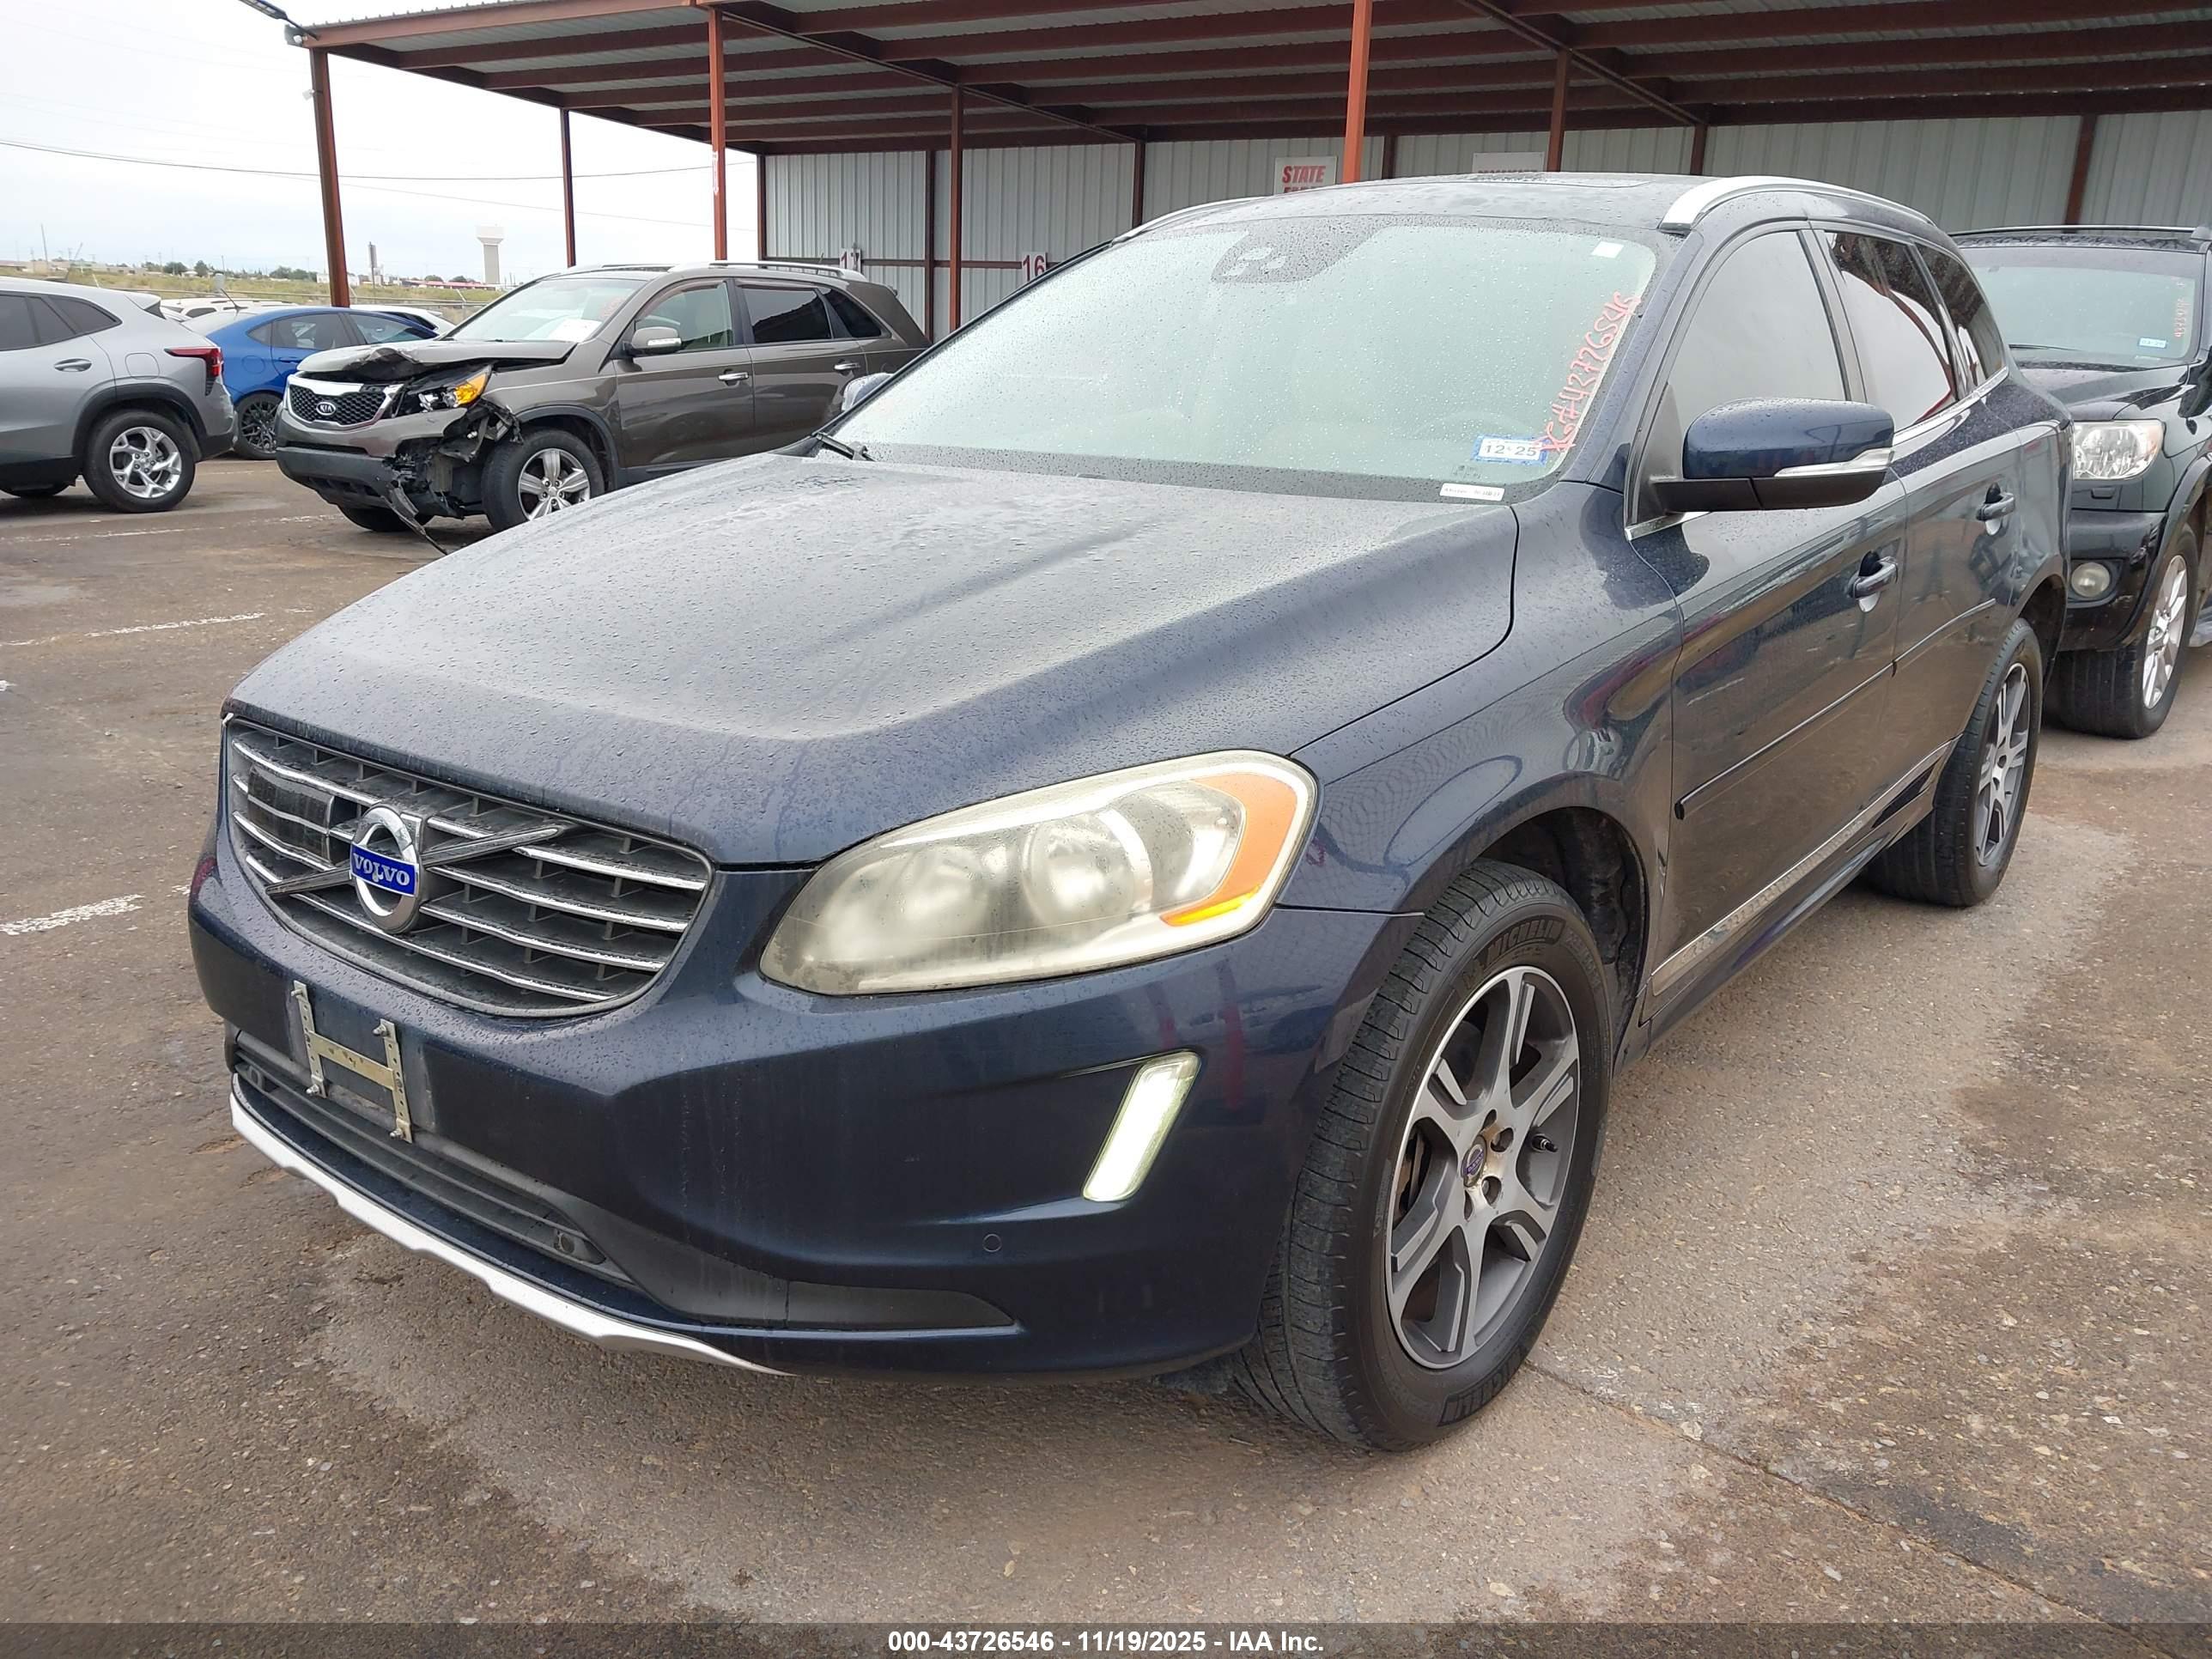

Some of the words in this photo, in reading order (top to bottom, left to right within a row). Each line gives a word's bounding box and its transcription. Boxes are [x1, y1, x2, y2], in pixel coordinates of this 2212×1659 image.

[1282, 165, 1327, 184] STATE
[1022, 254, 1046, 283] 16
[1484, 445, 1505, 454] 12
[1514, 446, 1537, 457] 25
[353, 853, 410, 886] VOLVO
